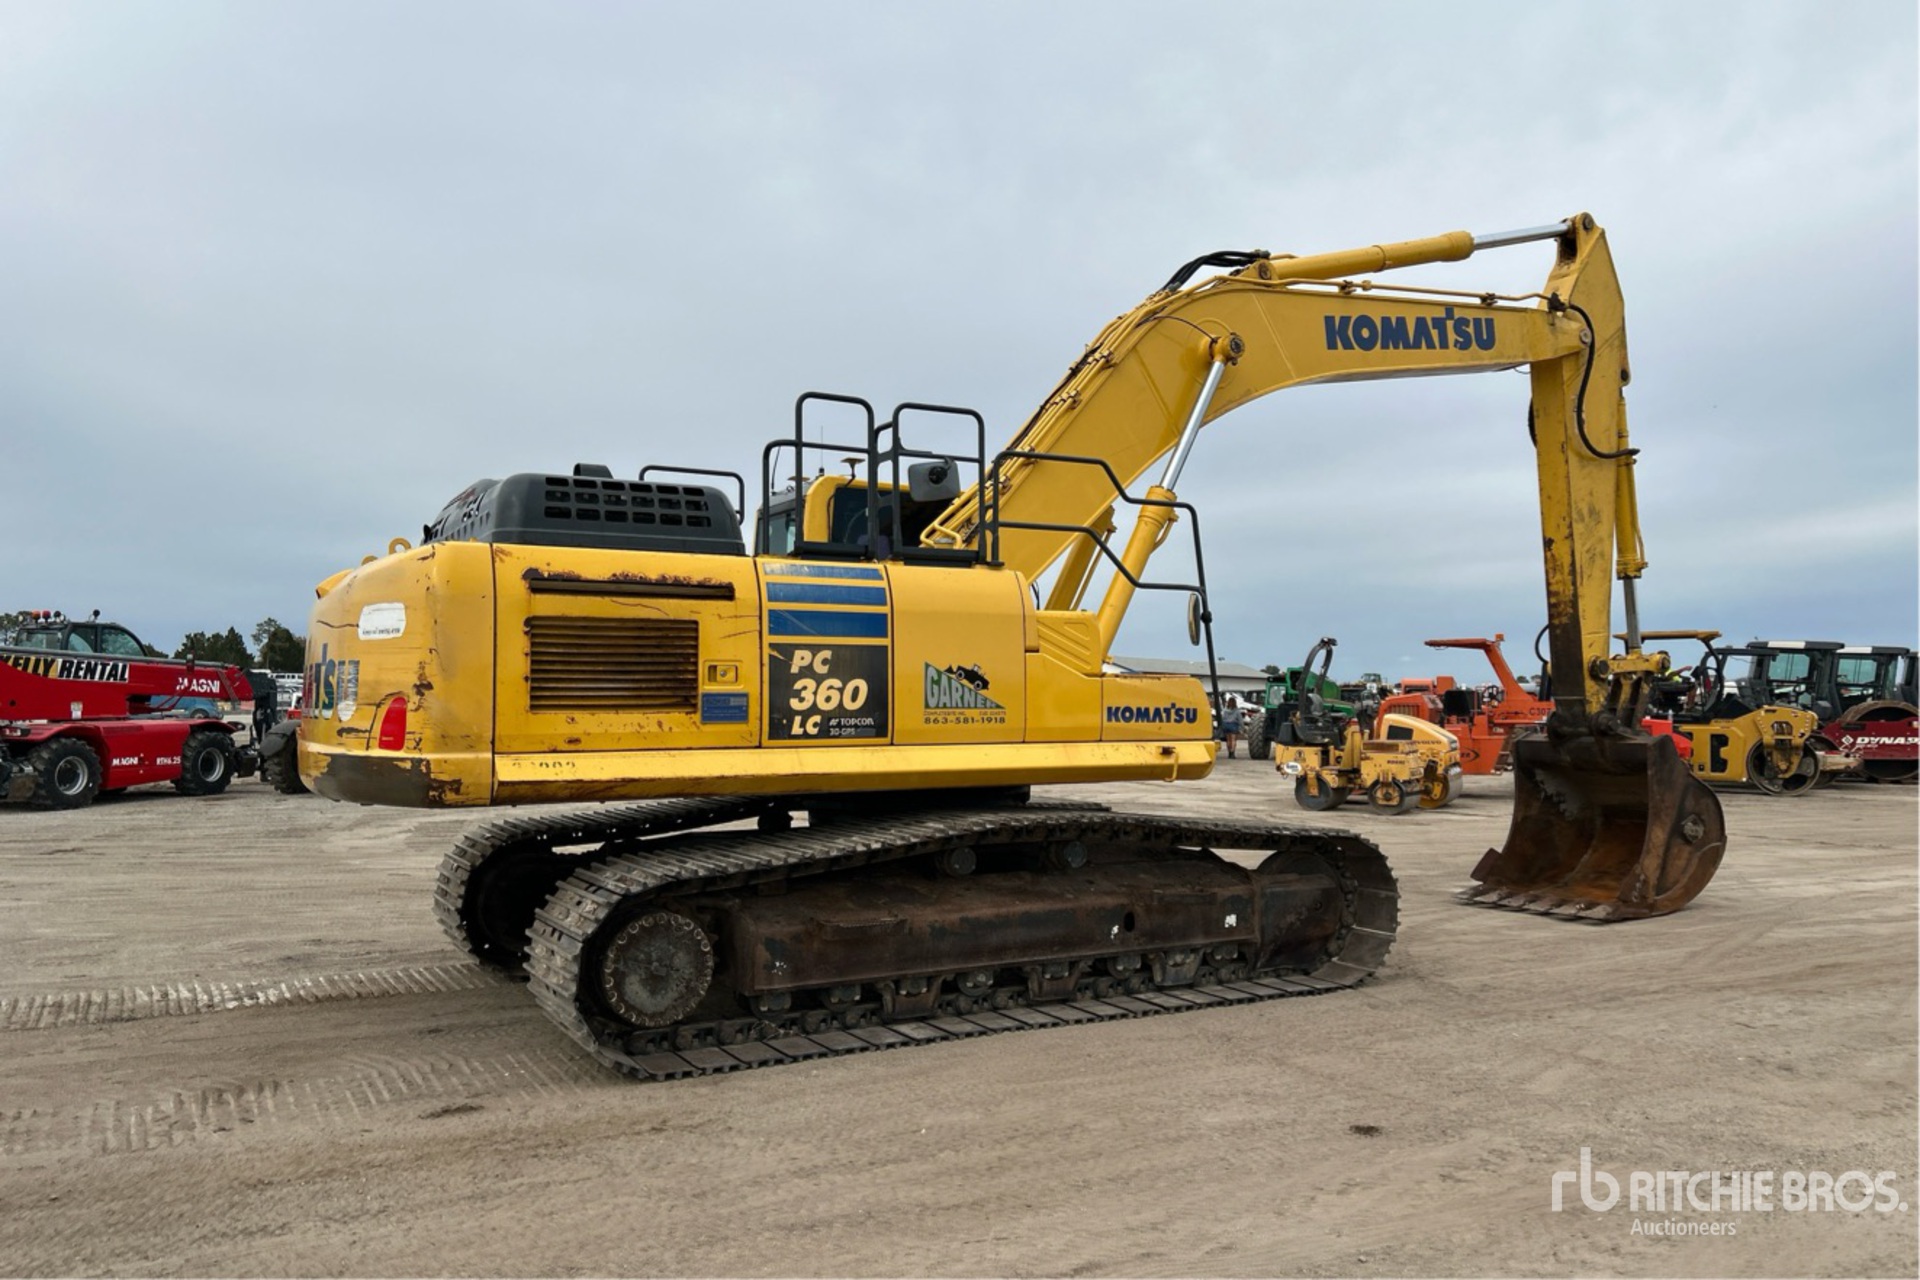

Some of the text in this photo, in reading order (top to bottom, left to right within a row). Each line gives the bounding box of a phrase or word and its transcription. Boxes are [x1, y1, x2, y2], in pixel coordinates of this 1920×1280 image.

[1324, 307, 1496, 351] KOMATSU
[58, 660, 128, 682] RENTAL
[790, 649, 833, 674] PC
[176, 676, 220, 693] MAGNI
[789, 678, 869, 711] 360
[926, 666, 998, 708] GARNER
[841, 717, 875, 726] TOPCON
[924, 716, 1006, 725] 863-581-1918
[1106, 702, 1197, 724] KOMATSU
[791, 715, 822, 735] LC
[1856, 736, 1919, 745] DYNAP
